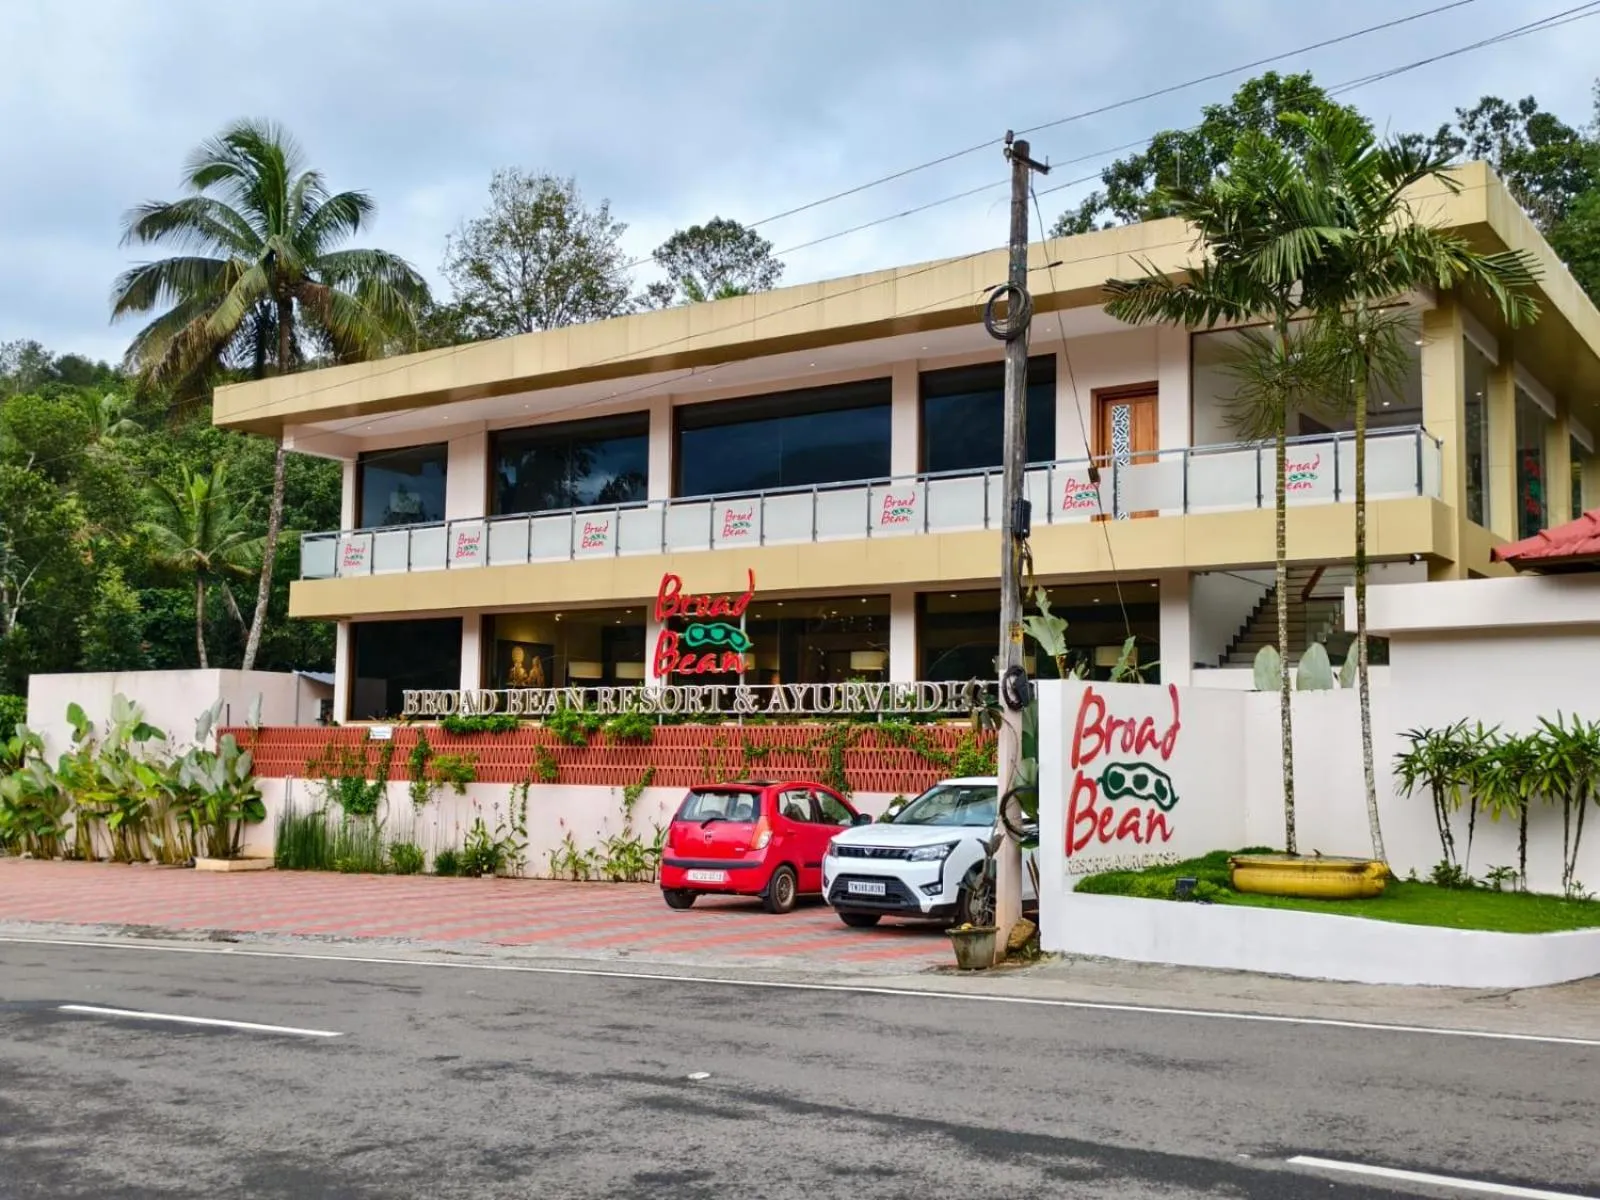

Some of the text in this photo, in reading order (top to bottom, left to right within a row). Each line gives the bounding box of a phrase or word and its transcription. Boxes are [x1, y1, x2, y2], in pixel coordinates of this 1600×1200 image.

[883, 491, 915, 509] Broad
[1062, 495, 1096, 511] Bean
[725, 505, 753, 522] Broad
[881, 510, 909, 525] Bean
[583, 520, 609, 535] Broad
[722, 524, 749, 538] Bean
[457, 530, 480, 545] Broad
[581, 536, 604, 549] Bean
[455, 546, 477, 558] Bean
[655, 567, 755, 623] Broad
[653, 629, 749, 679] Bean
[402, 689, 498, 716] BROAD
[506, 687, 586, 715] BEAN
[595, 685, 729, 715] RESORT
[733, 684, 759, 714] &
[1071, 683, 1181, 770] Broad
[1065, 769, 1175, 857] Bean
